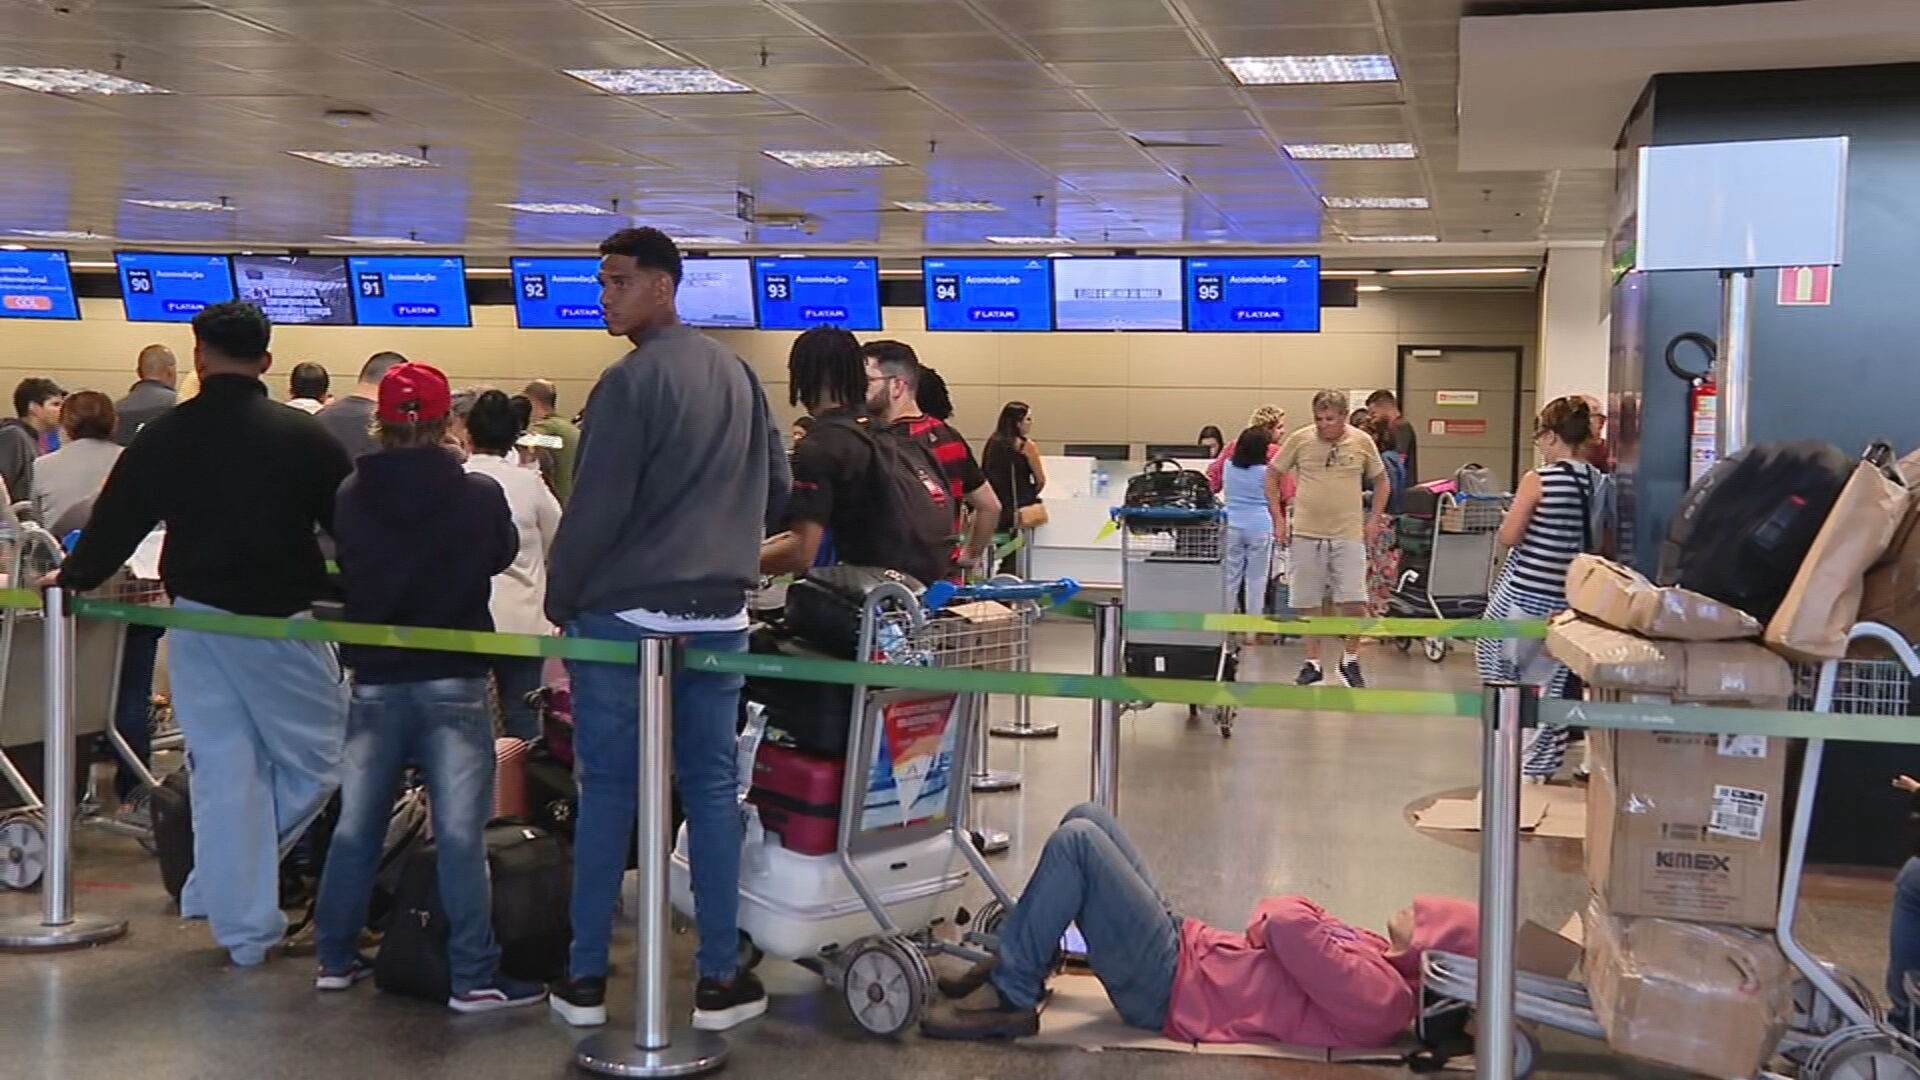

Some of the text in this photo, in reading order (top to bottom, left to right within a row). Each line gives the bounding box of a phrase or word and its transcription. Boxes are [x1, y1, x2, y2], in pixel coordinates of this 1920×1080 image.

[132, 278, 149, 291] 90
[796, 275, 847, 284] Acomodação
[965, 275, 1020, 284] Acomodação
[1229, 275, 1288, 285] Acomodação
[363, 282, 380, 295] 91
[525, 283, 544, 297] 92
[767, 284, 787, 298] 93
[936, 284, 956, 299] 94
[1198, 285, 1219, 300] 95
[982, 310, 1015, 318] LATAM
[1246, 310, 1280, 319] LATAM
